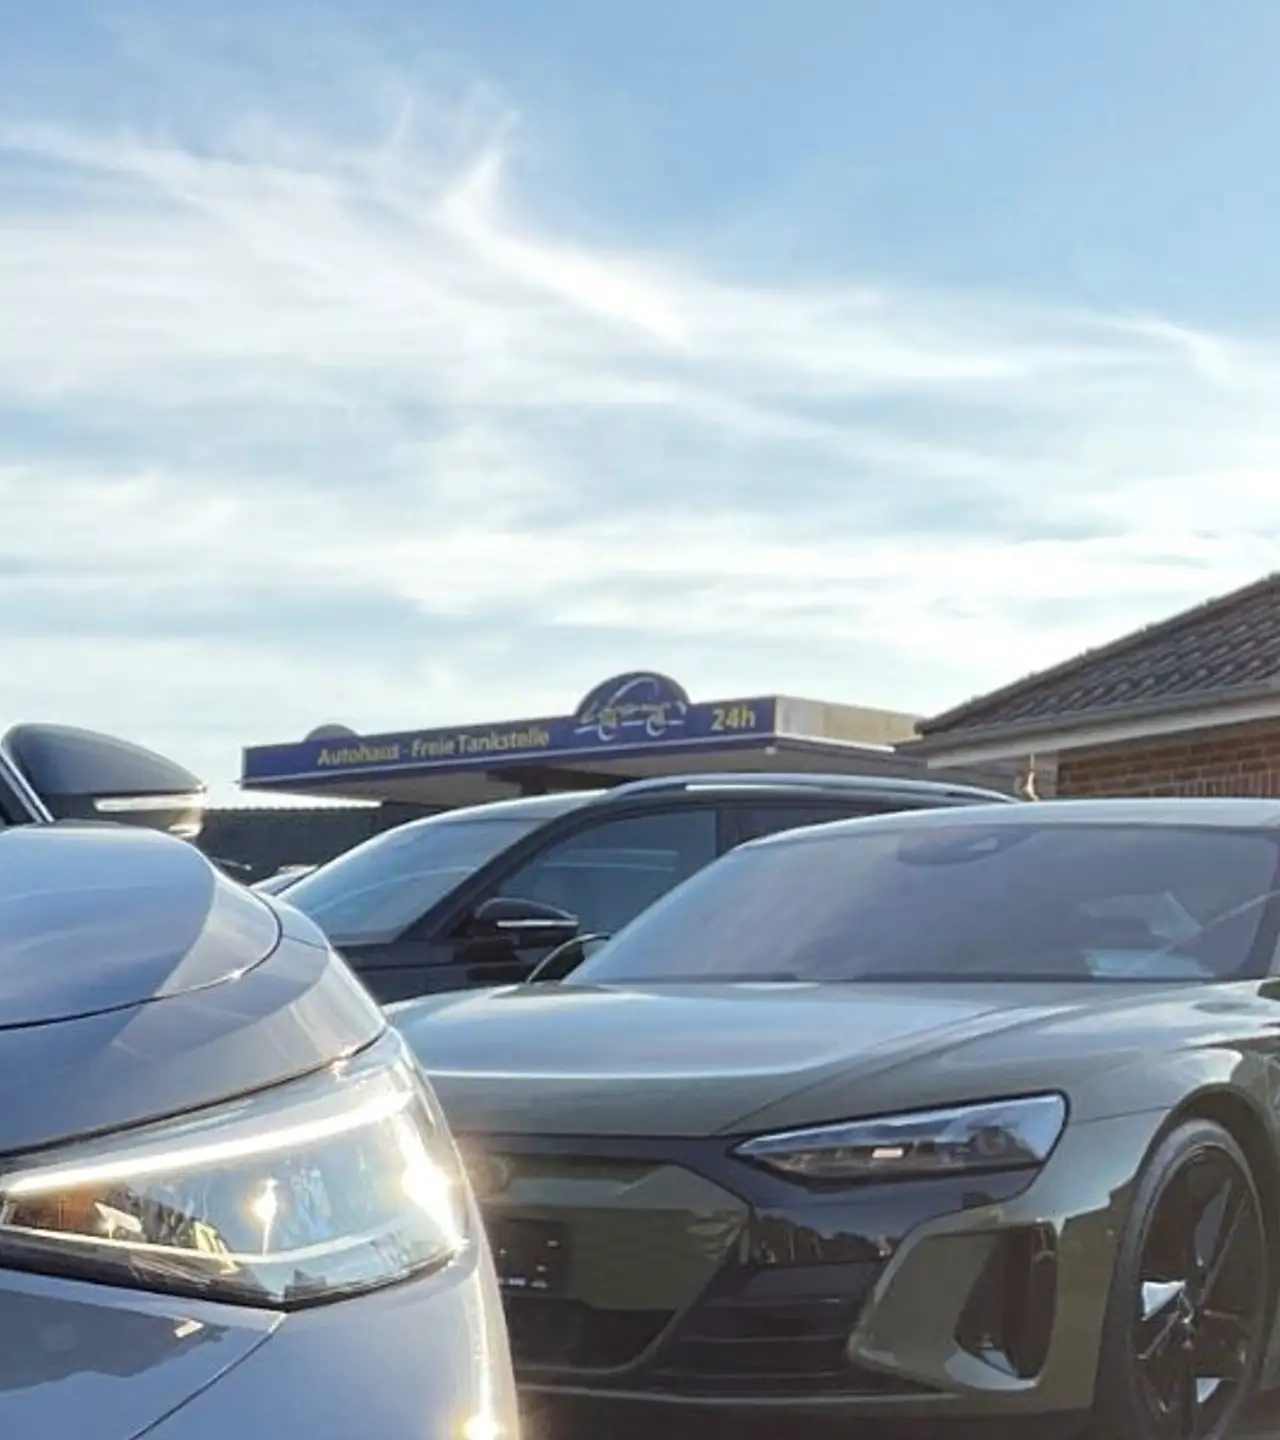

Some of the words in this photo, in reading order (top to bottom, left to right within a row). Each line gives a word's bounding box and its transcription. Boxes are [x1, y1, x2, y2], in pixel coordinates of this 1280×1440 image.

[710, 705, 756, 731] 24h
[317, 743, 399, 766] Autohaus
[411, 737, 454, 757] Freie
[458, 729, 550, 755] Tankstelle
